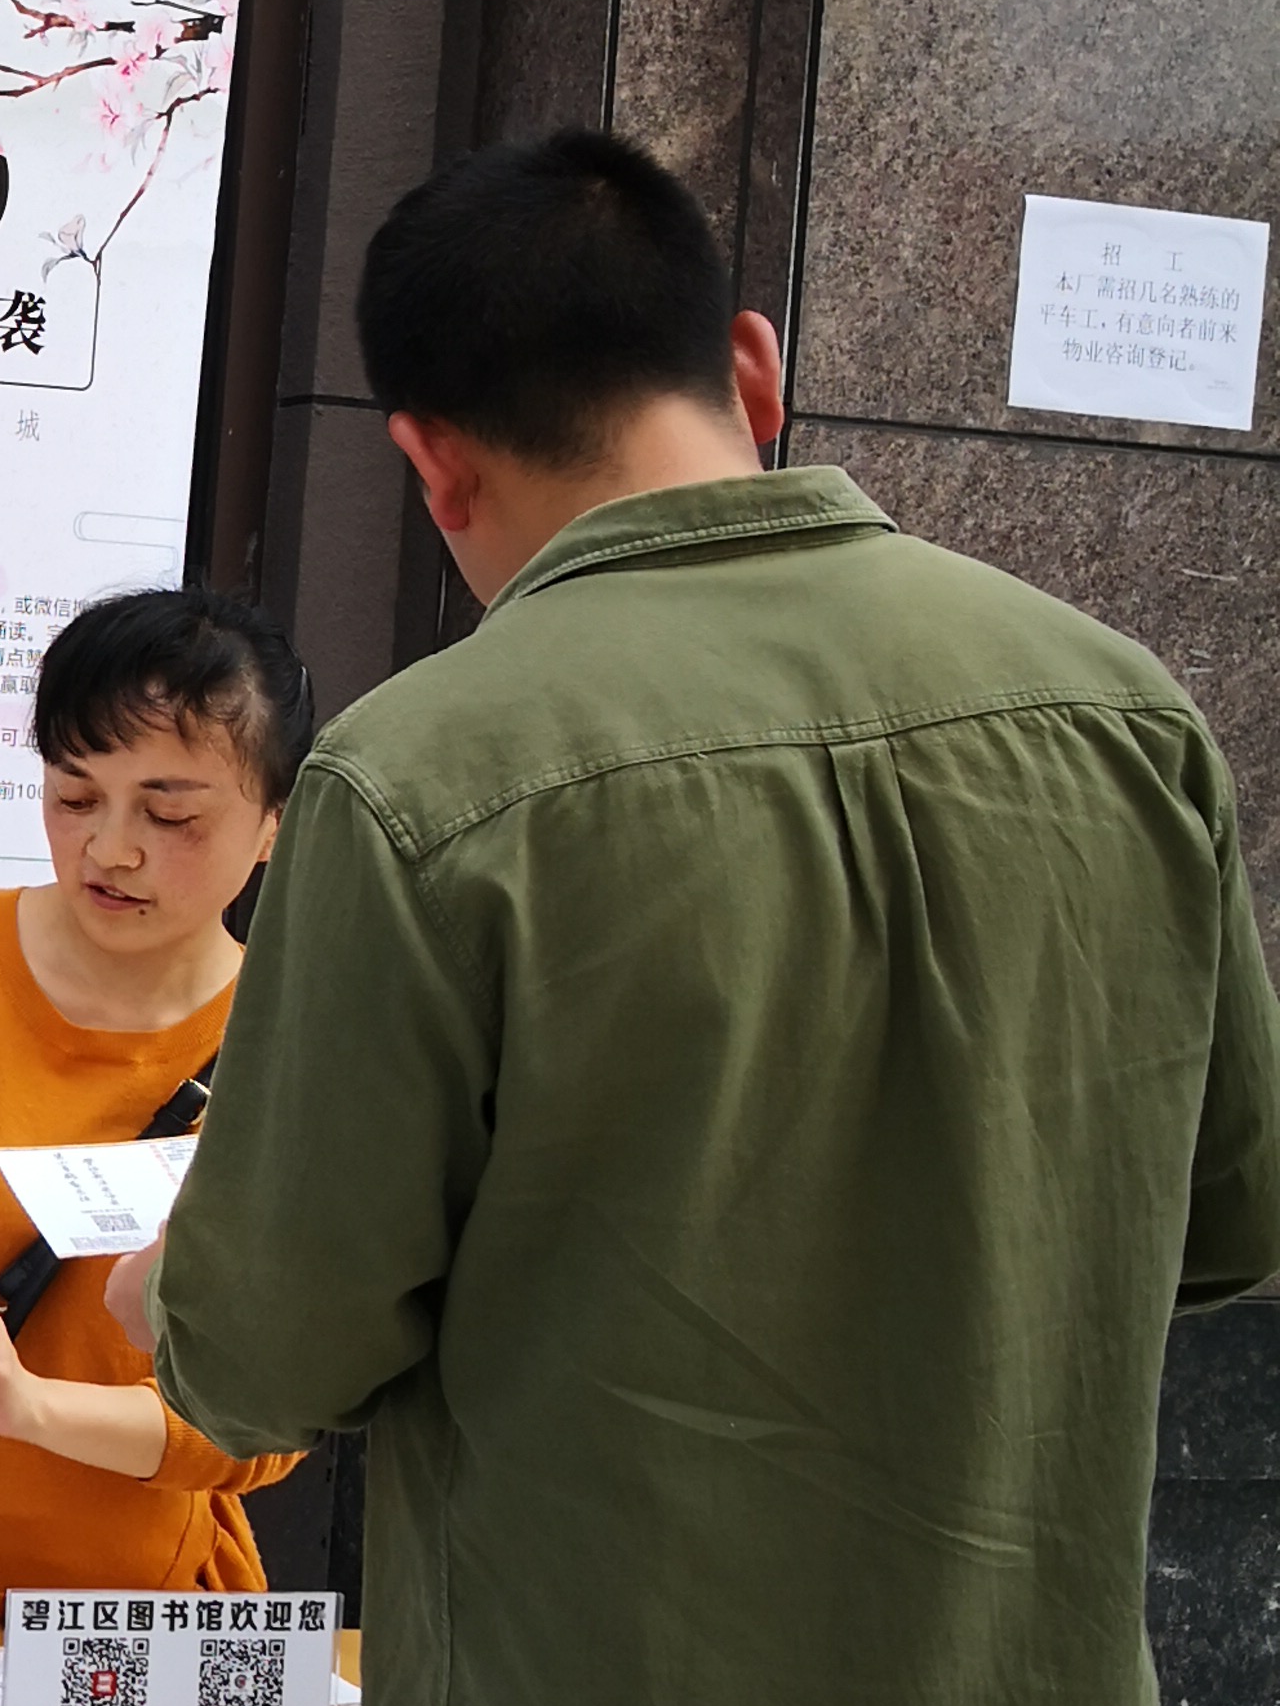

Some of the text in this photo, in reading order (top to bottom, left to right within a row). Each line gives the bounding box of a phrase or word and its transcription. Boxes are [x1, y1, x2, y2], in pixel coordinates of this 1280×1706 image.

[22, 1599, 327, 1633] 碧江区图书馆欢迎您
